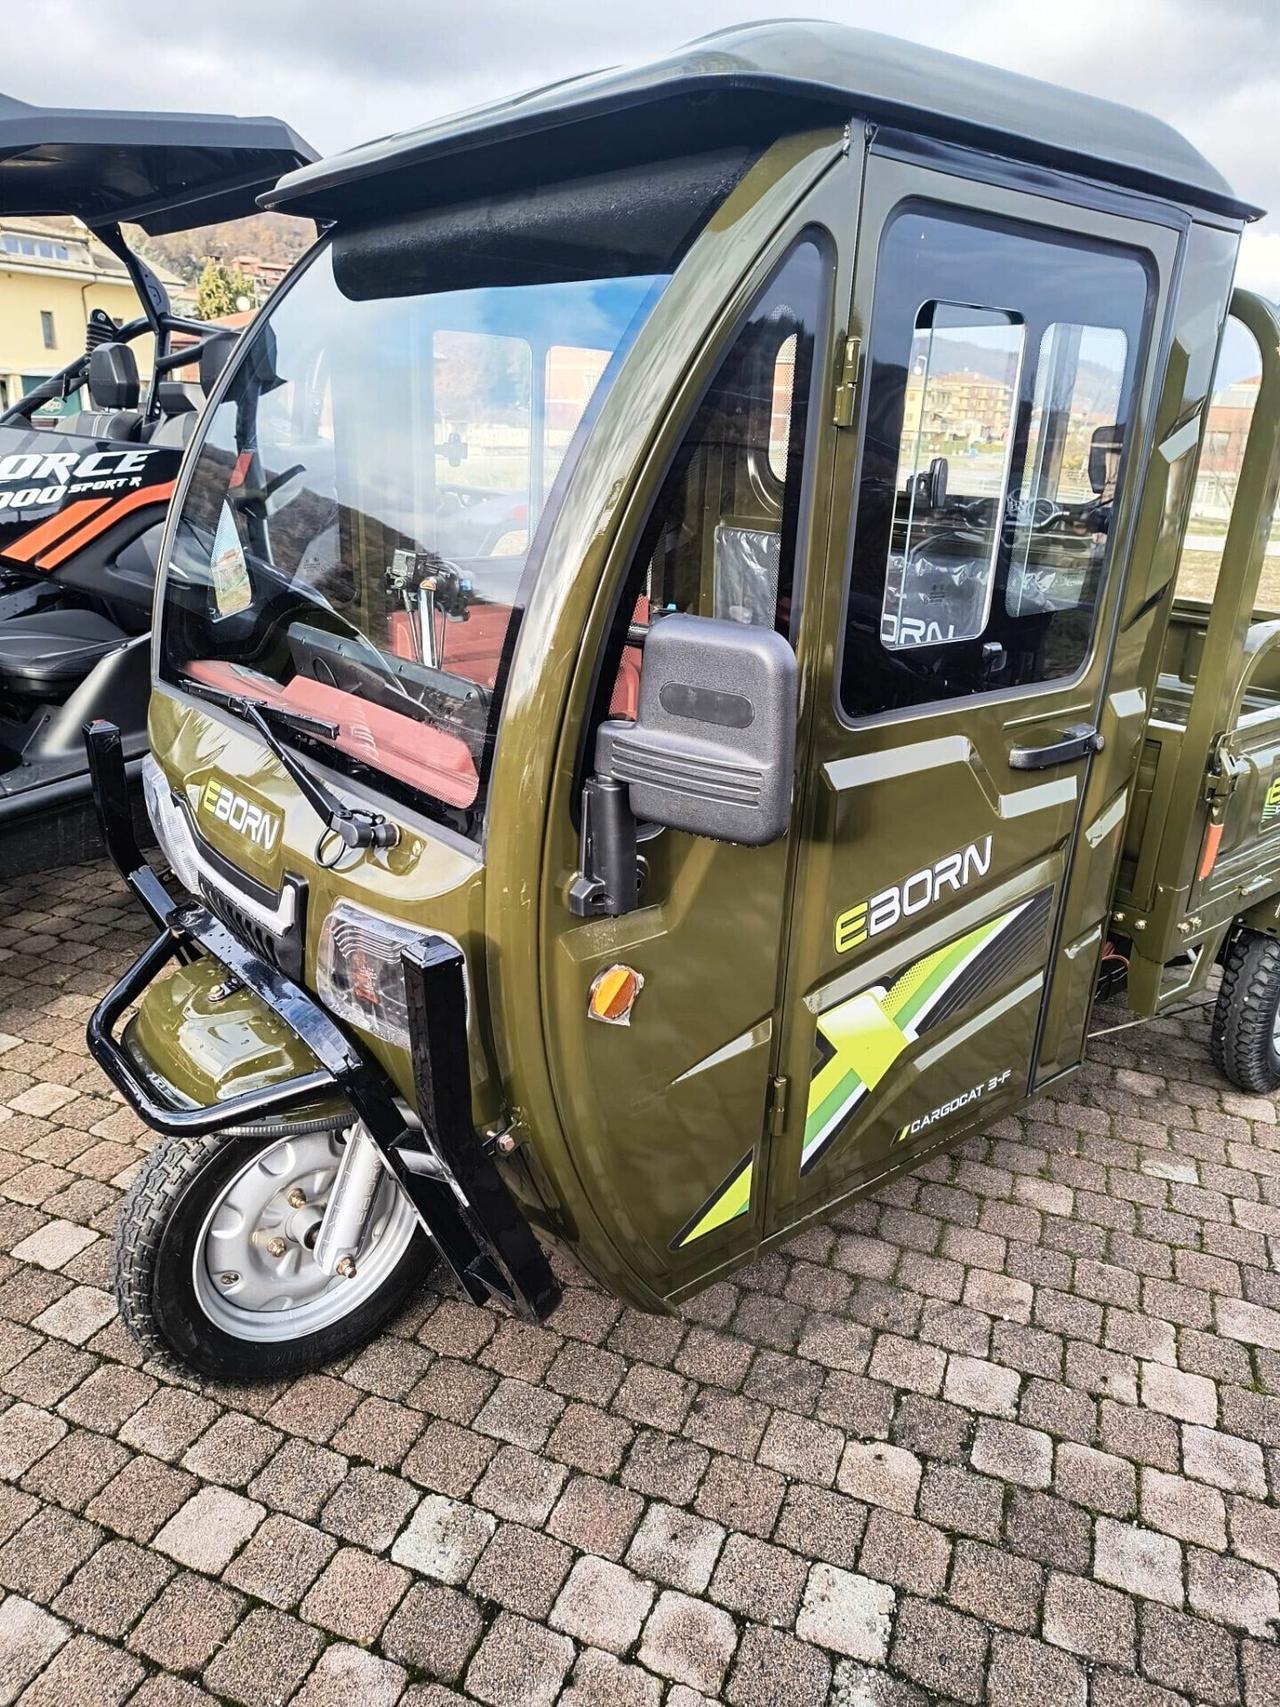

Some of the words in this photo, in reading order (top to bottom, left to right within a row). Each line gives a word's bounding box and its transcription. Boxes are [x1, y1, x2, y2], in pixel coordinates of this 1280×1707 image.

[68, 478, 128, 494] SPORT
[129, 476, 143, 488] R
[203, 779, 280, 850] EBORN
[835, 835, 993, 954] EBORN
[910, 1083, 985, 1134] CARGOCAT
[987, 1069, 1012, 1091] 3-F
